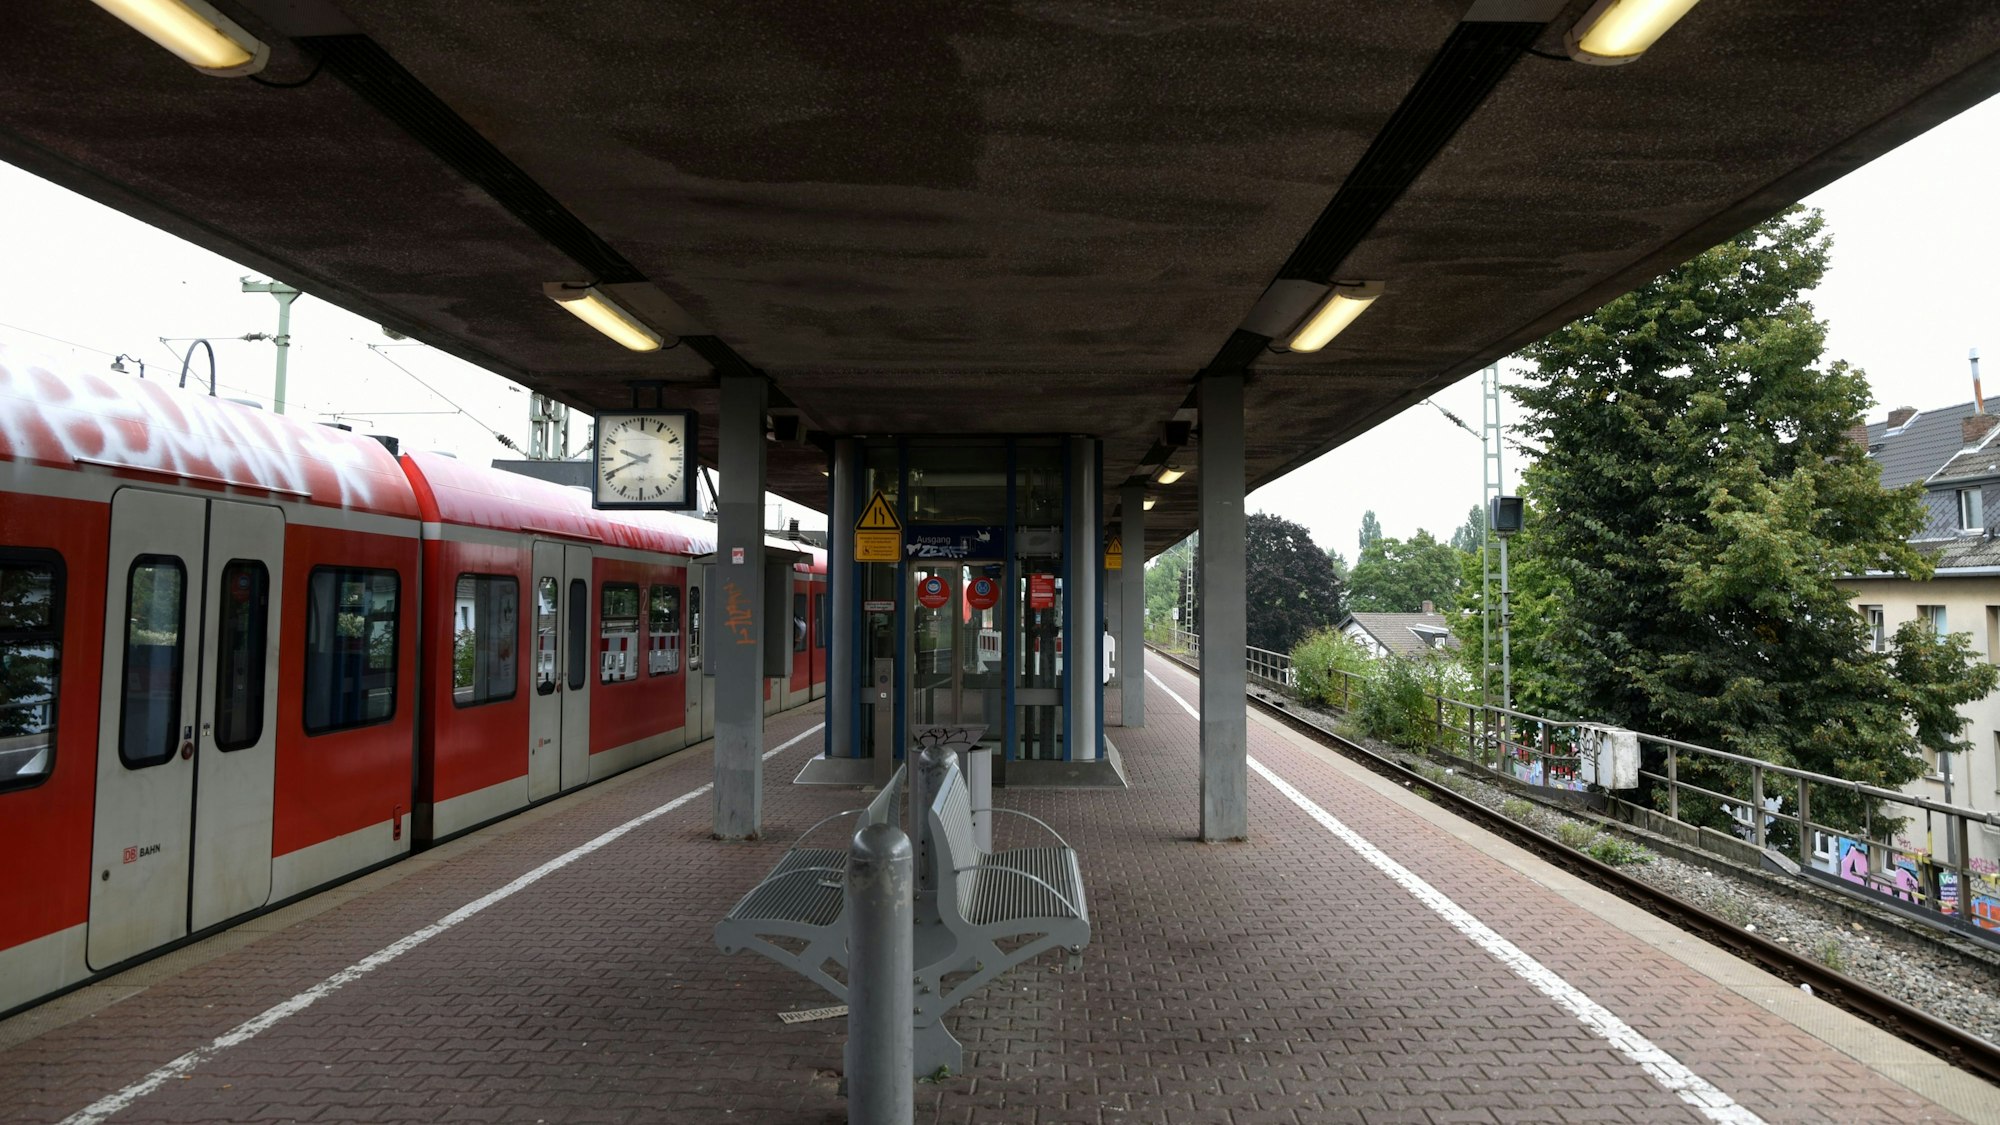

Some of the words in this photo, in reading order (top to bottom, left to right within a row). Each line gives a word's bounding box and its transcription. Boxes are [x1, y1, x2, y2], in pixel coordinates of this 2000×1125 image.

[917, 536, 951, 545] Ausgang
[641, 588, 648, 615] 2
[124, 847, 136, 862] DB
[139, 843, 161, 857] BAHN
